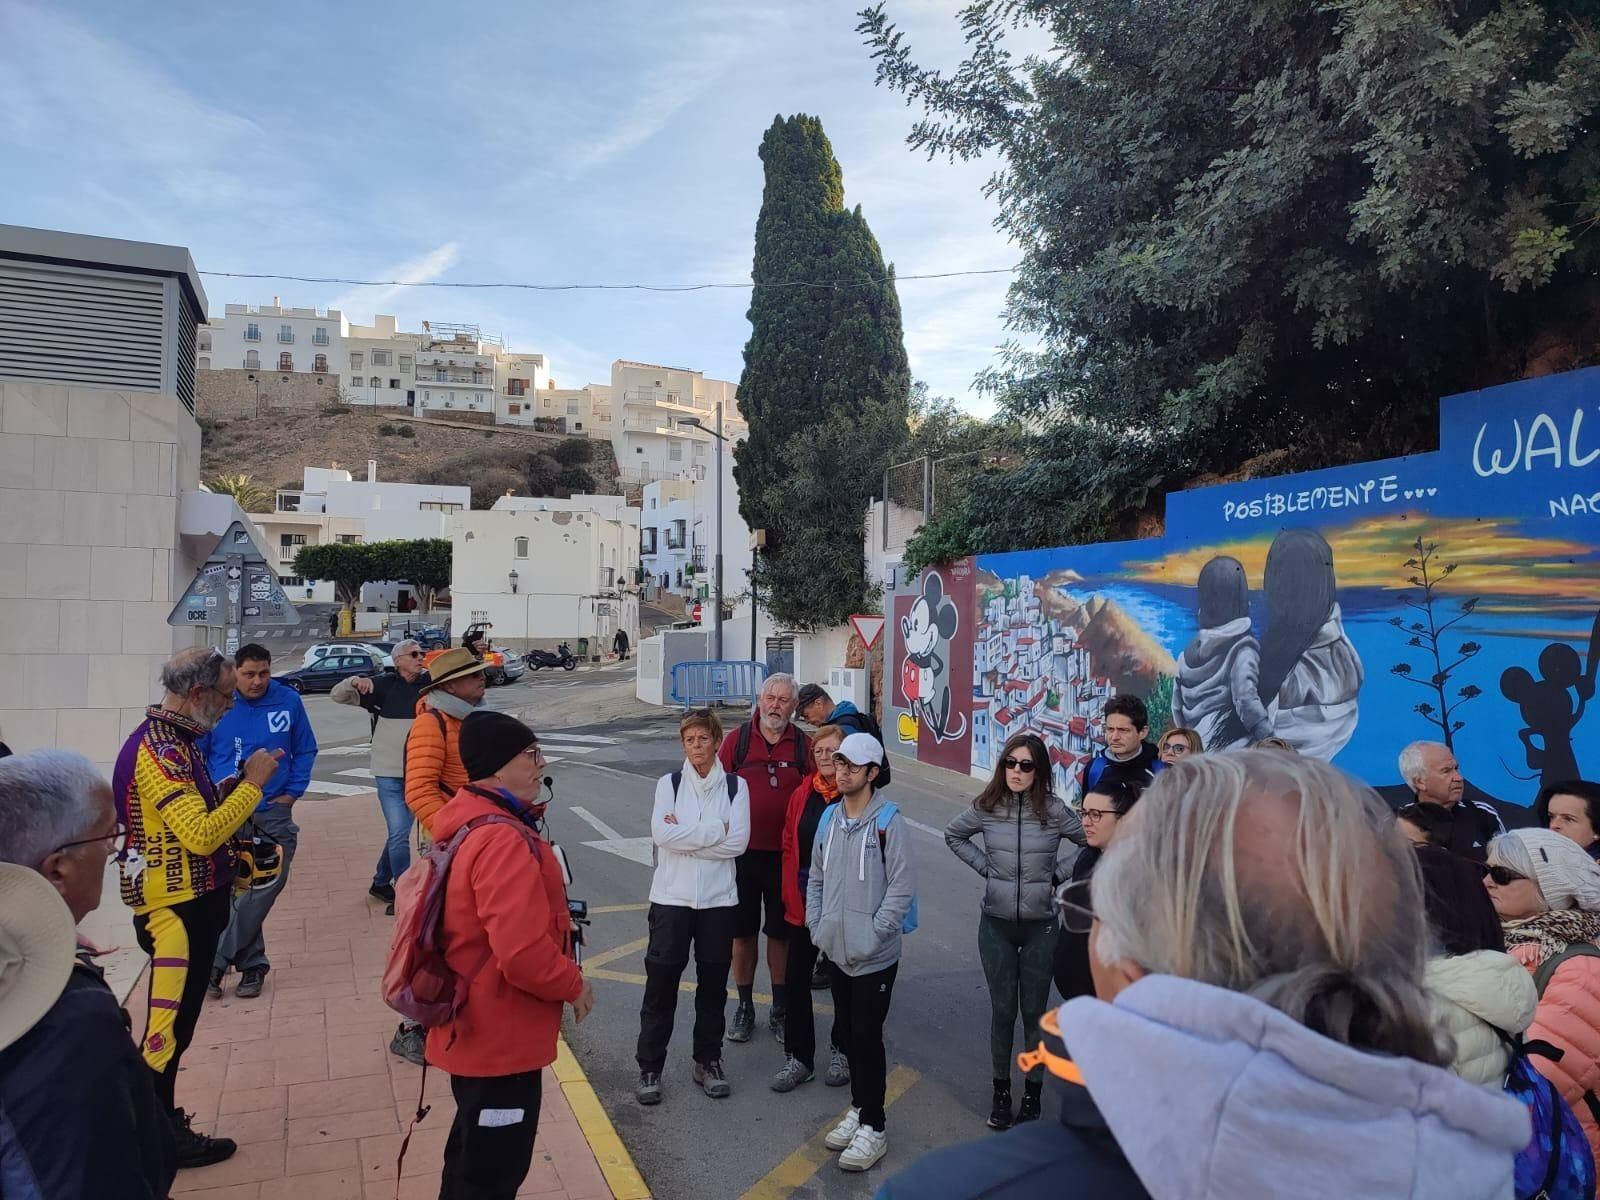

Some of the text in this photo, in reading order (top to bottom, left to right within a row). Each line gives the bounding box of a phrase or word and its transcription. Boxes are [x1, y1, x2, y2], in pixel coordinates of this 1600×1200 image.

[1473, 408, 1600, 477] WAL
[188, 610, 208, 621] OCRE
[147, 831, 162, 868] G.D.C.
[165, 846, 185, 893] PUEBLO
